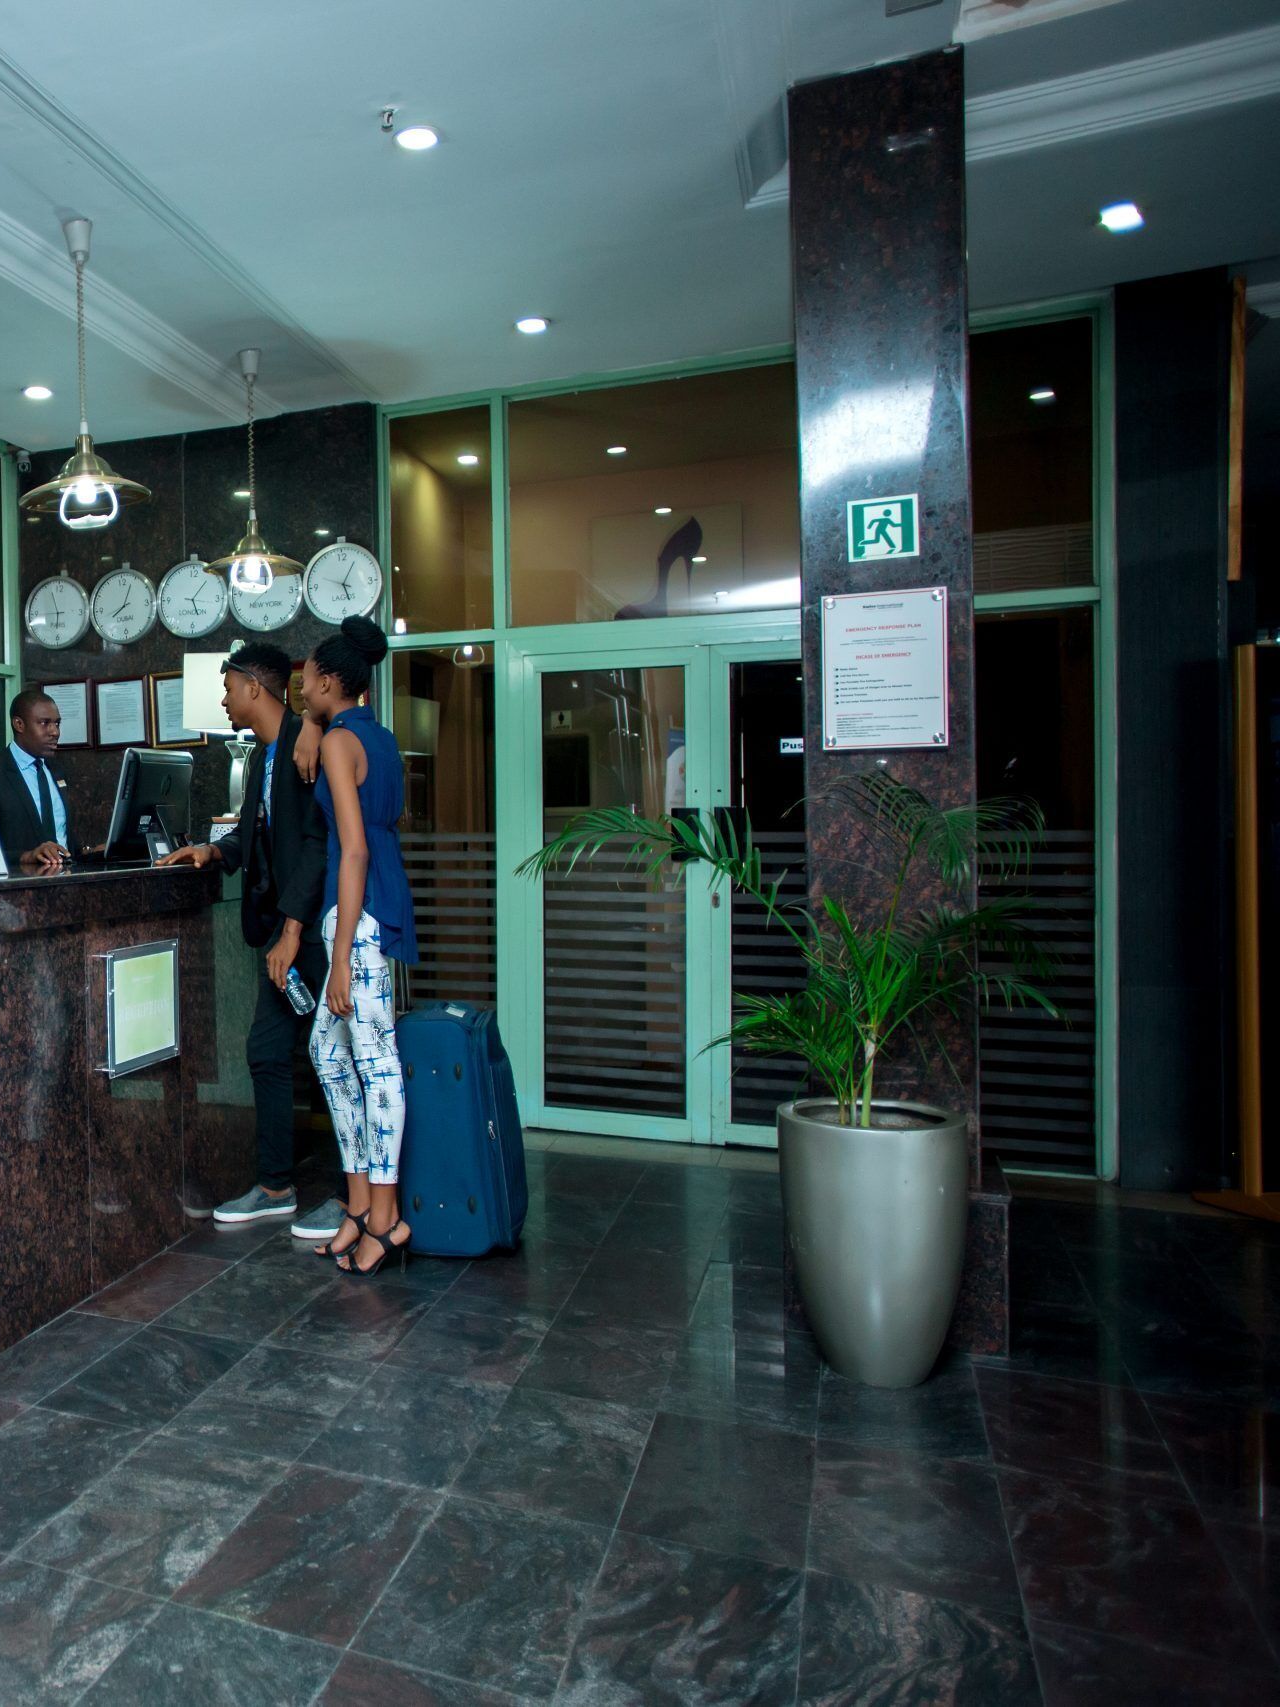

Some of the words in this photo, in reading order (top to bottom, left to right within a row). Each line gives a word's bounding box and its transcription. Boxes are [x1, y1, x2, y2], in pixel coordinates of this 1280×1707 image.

[337, 553, 347, 562] 12
[190, 570, 199, 578] 12
[119, 578, 127, 586] 12
[367, 577, 373, 585] 3
[55, 585, 64, 593] 12
[289, 585, 294, 593] 3
[166, 596, 171, 604] 9
[215, 594, 220, 603] 3
[342, 607, 347, 615] 6
[117, 615, 134, 623] DUBAI
[782, 742, 803, 750] Pus
